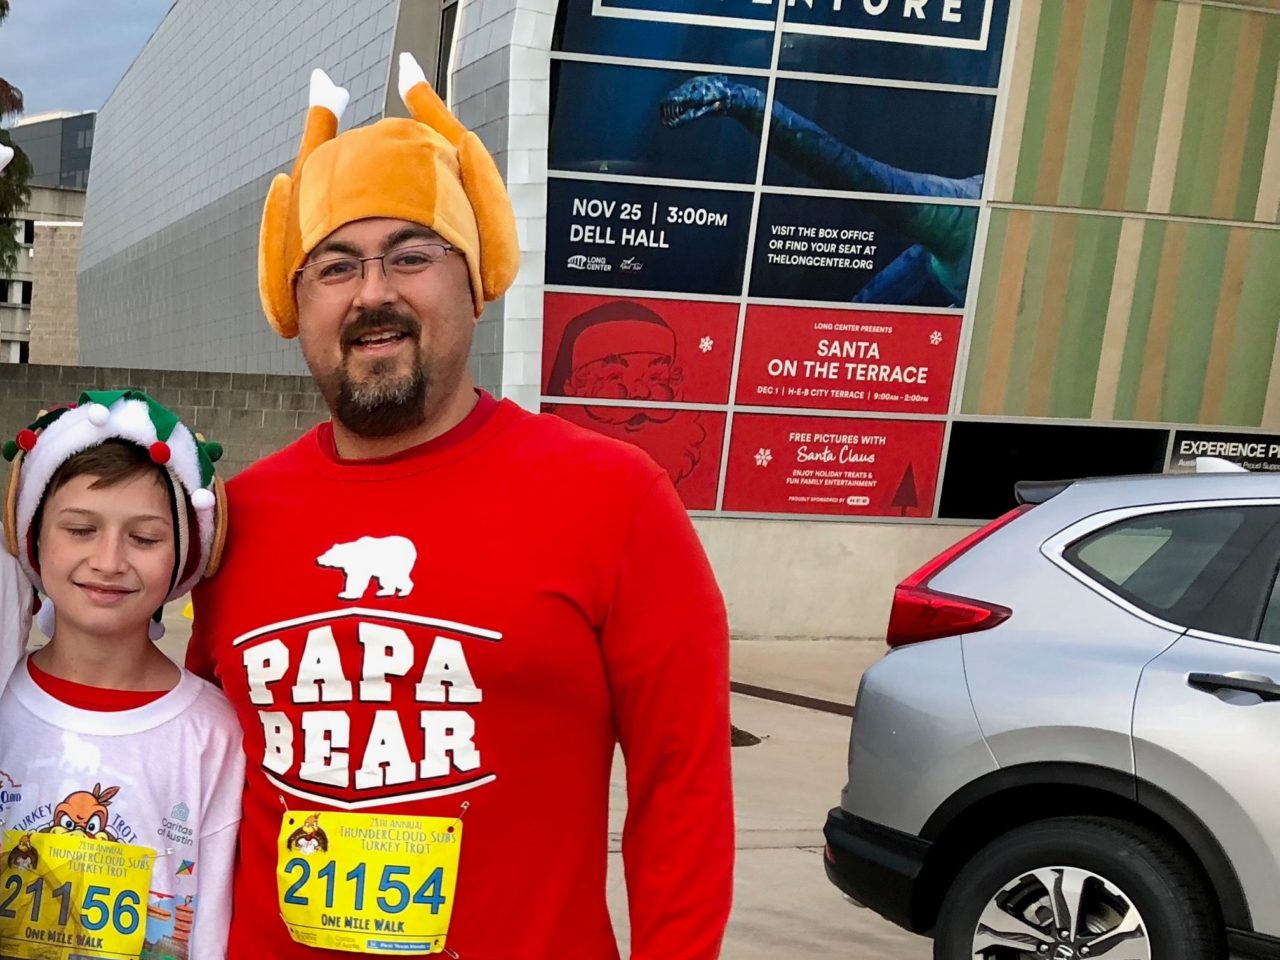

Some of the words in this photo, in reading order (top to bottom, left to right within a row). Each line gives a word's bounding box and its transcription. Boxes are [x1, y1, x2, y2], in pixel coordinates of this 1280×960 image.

[572, 198, 616, 219] NOV
[620, 203, 642, 221] 25
[667, 206, 728, 227] 3:00PM
[570, 224, 616, 245] DELL
[621, 228, 670, 249] HALL
[771, 225, 796, 236] VISIT
[798, 226, 816, 237] THE
[818, 228, 838, 239] BOX
[840, 230, 874, 241] OFFICE
[769, 240, 783, 250] OR
[785, 240, 808, 251] FIND
[810, 242, 836, 253] YOUR
[838, 244, 862, 254] SEAT
[863, 245, 877, 256] AT
[586, 263, 612, 271] CENTER
[587, 256, 606, 264] LONG
[767, 253, 873, 270] THELONGCENTER.ORG
[814, 322, 833, 331] LONG
[834, 323, 860, 332] CENTER
[861, 325, 893, 334] PRESENTS
[817, 339, 880, 359] SANTA
[768, 359, 798, 377] ON
[803, 361, 840, 379] THE
[844, 363, 928, 384] TERRACE
[757, 385, 774, 394] DEC
[811, 389, 829, 397] CITY
[831, 390, 865, 399] TERRACE
[789, 432, 812, 442] FREE
[814, 433, 859, 444] PICTURES
[861, 435, 887, 445] WITH
[797, 445, 836, 462] Santa
[839, 445, 875, 464] Claus
[1180, 440, 1267, 457] EXPERIENCE
[792, 469, 814, 477] ENJOY
[815, 470, 842, 478] HOLIDAY
[844, 471, 867, 479] TREATS
[243, 621, 483, 705] PAPA
[258, 709, 481, 790] BEAR
[12, 803, 52, 831] TURKEY
[112, 813, 138, 844] TROT
[161, 817, 193, 835] Caritas
[166, 831, 194, 847] Austin
[361, 839, 400, 852] TURKEY
[405, 841, 431, 854] TROT
[68, 860, 106, 874] TURKEY
[107, 864, 128, 878] TROT
[283, 856, 447, 915] 21154
[322, 914, 341, 927] ONE
[344, 916, 370, 930] MILE
[374, 918, 405, 932] WALK
[26, 926, 45, 940] ONE
[47, 929, 72, 945] MILE
[76, 934, 105, 949] WALK
